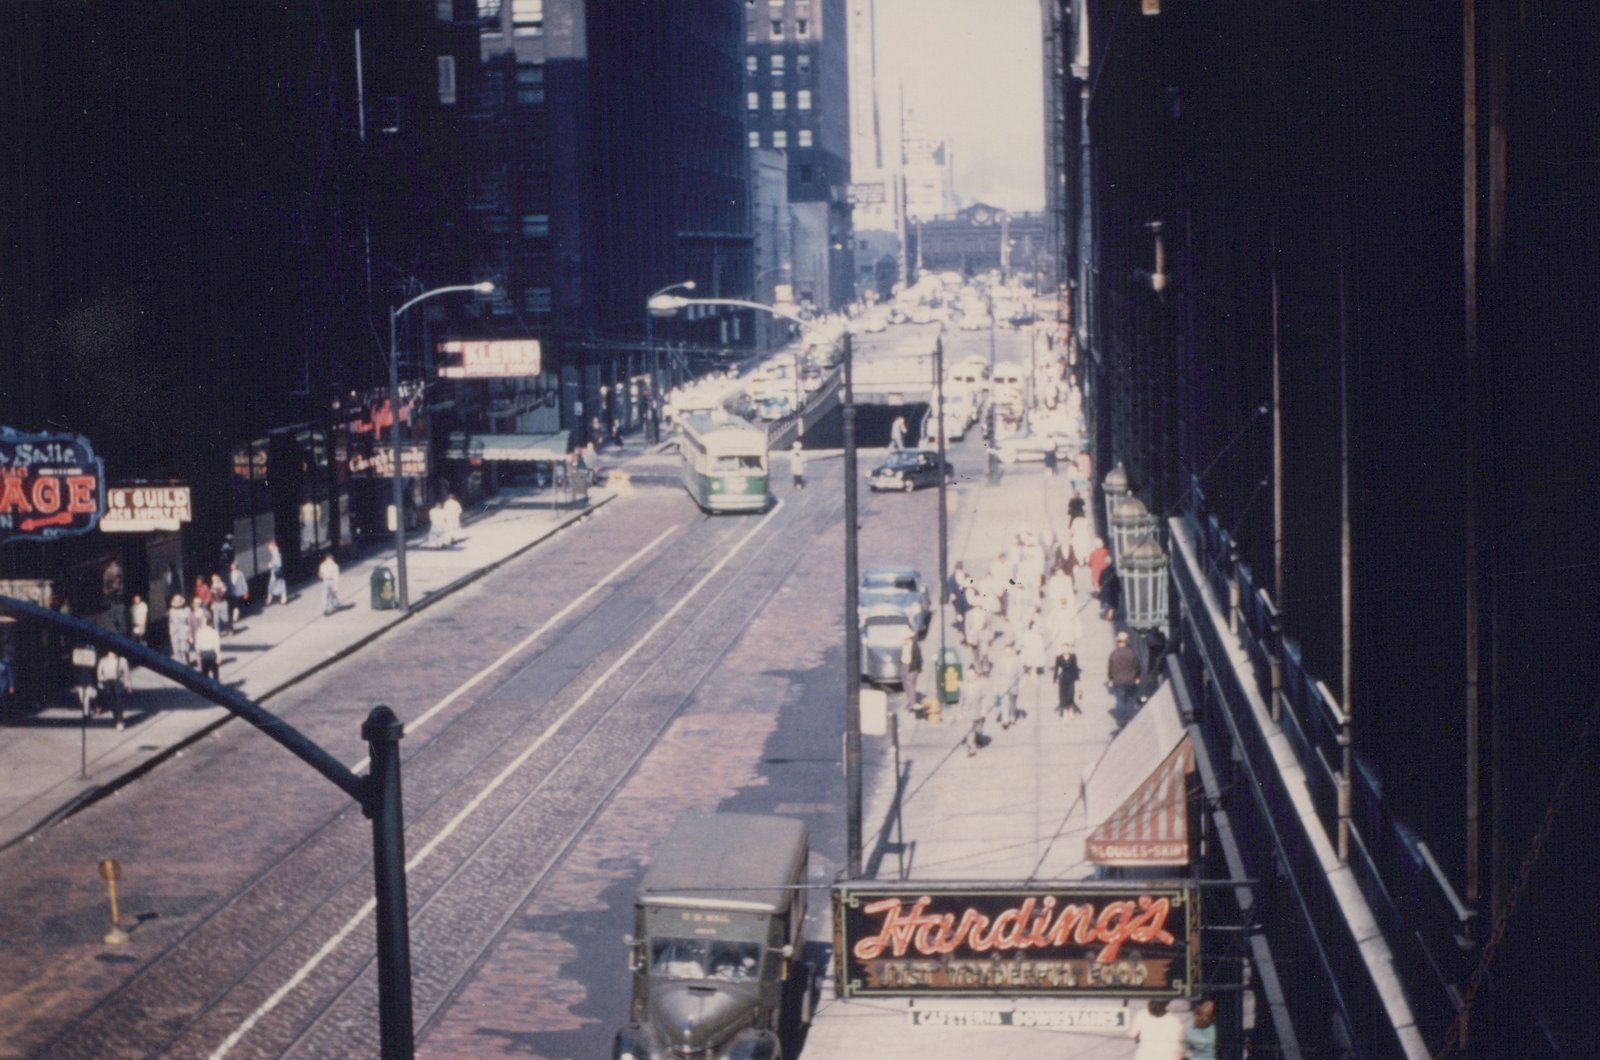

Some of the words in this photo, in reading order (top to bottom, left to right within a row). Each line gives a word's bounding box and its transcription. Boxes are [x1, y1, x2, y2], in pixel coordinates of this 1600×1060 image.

[13, 443, 77, 466] Salle
[132, 488, 188, 508] GUILD
[854, 895, 1175, 962] Harding's
[1087, 961, 1148, 986] FOOD
